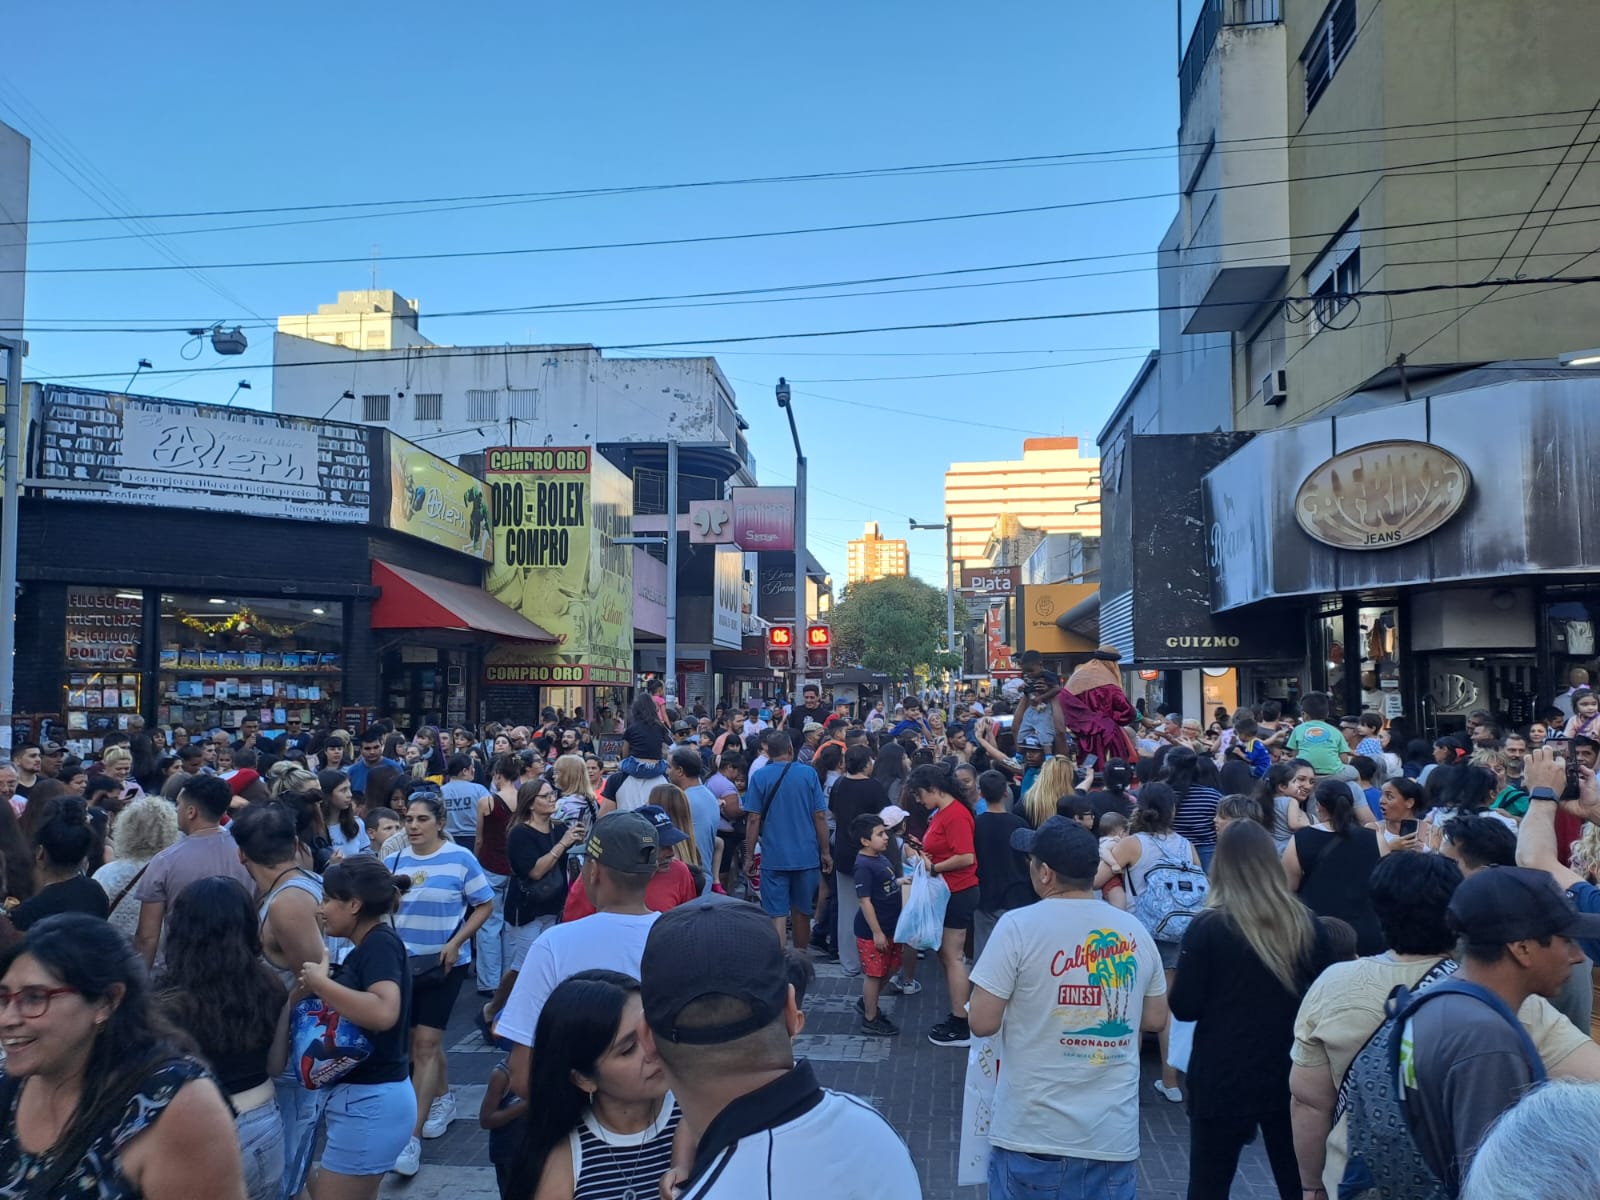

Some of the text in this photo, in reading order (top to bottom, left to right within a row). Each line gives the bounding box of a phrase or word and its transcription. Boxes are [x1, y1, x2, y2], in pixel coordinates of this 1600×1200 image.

[490, 450, 587, 471] COMPRO ORO
[492, 481, 524, 528] ORO
[536, 481, 584, 527] ROLEX
[1363, 530, 1402, 545] JEANS
[505, 528, 569, 567] COMPRO
[971, 576, 1011, 590] Plata
[773, 630, 788, 643] 06
[811, 629, 827, 643] 06
[1166, 636, 1240, 648] GUIZMO
[486, 666, 583, 681] COMPRO ORO
[1050, 932, 1137, 976] California's
[1060, 986, 1100, 1005] FINEST
[1060, 1038, 1116, 1048] CORONADO
